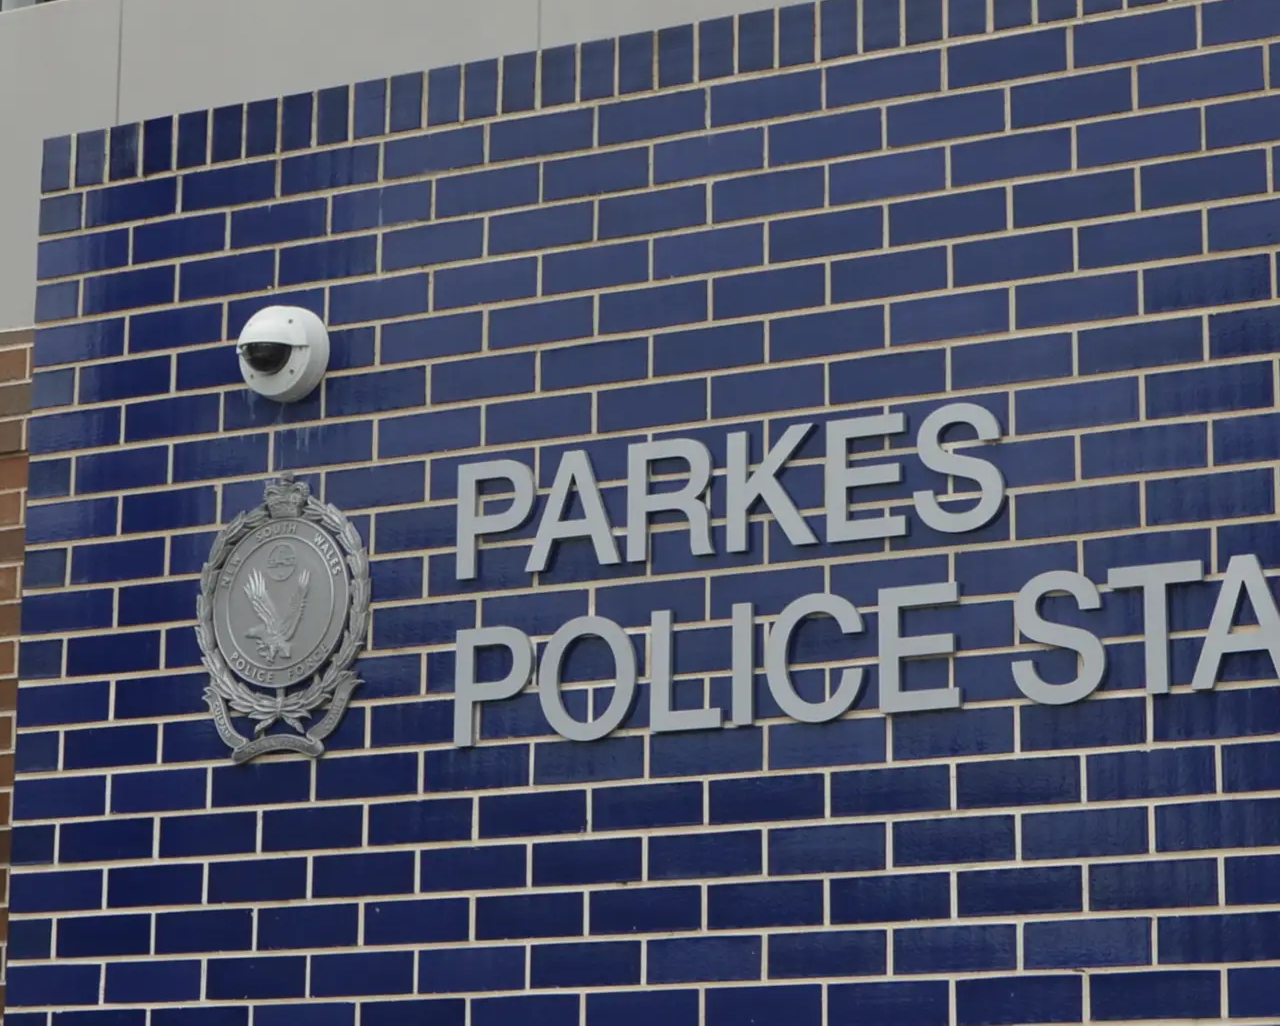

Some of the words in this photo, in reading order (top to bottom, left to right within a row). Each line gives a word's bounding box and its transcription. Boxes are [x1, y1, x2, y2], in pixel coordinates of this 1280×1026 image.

[457, 402, 1006, 579] PARKES
[220, 555, 242, 589] NEW
[256, 523, 298, 542] SOUTH
[314, 532, 342, 576] WALES
[230, 651, 274, 683] POLICE
[288, 643, 330, 681] FORCE
[454, 581, 963, 748] POLICE
